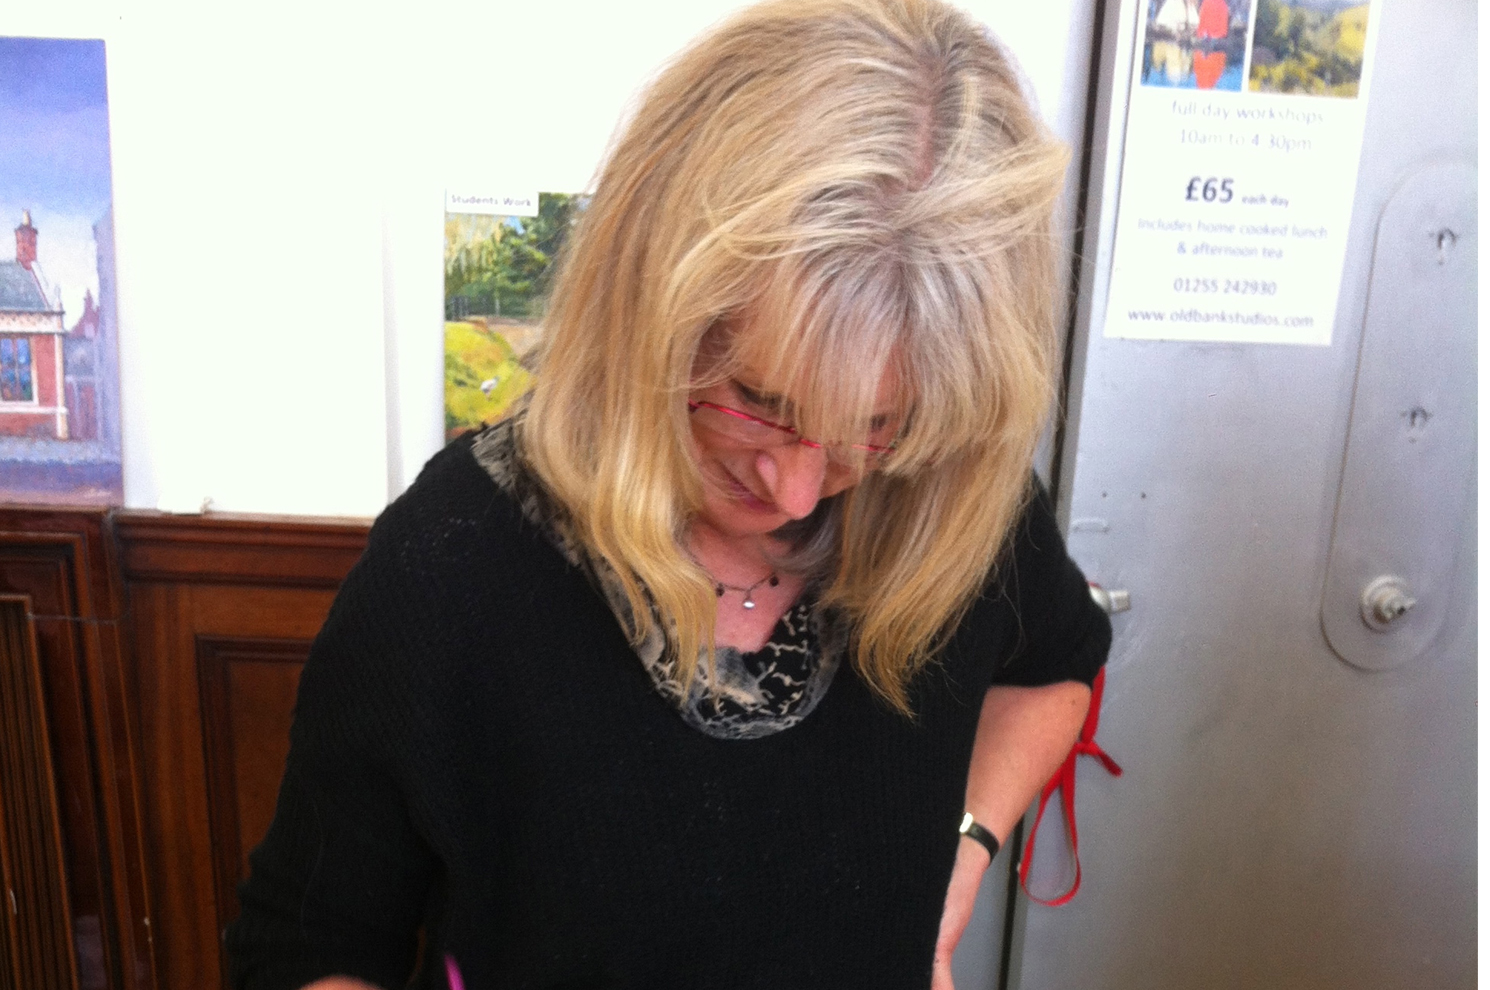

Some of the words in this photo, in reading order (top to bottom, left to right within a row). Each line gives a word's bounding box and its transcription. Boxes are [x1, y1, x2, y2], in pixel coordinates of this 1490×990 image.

[1172, 101, 1197, 116] full
[1202, 103, 1230, 121] day
[1236, 105, 1324, 124] workshops
[1185, 176, 1234, 204] £65
[1242, 194, 1267, 206] each
[1270, 195, 1289, 208] day
[1197, 220, 1236, 235] home
[1239, 223, 1288, 237] cooked
[1291, 225, 1328, 239] lunch
[1192, 243, 1258, 257] afternoon
[1262, 247, 1283, 259] tea
[1173, 278, 1219, 293] 01255
